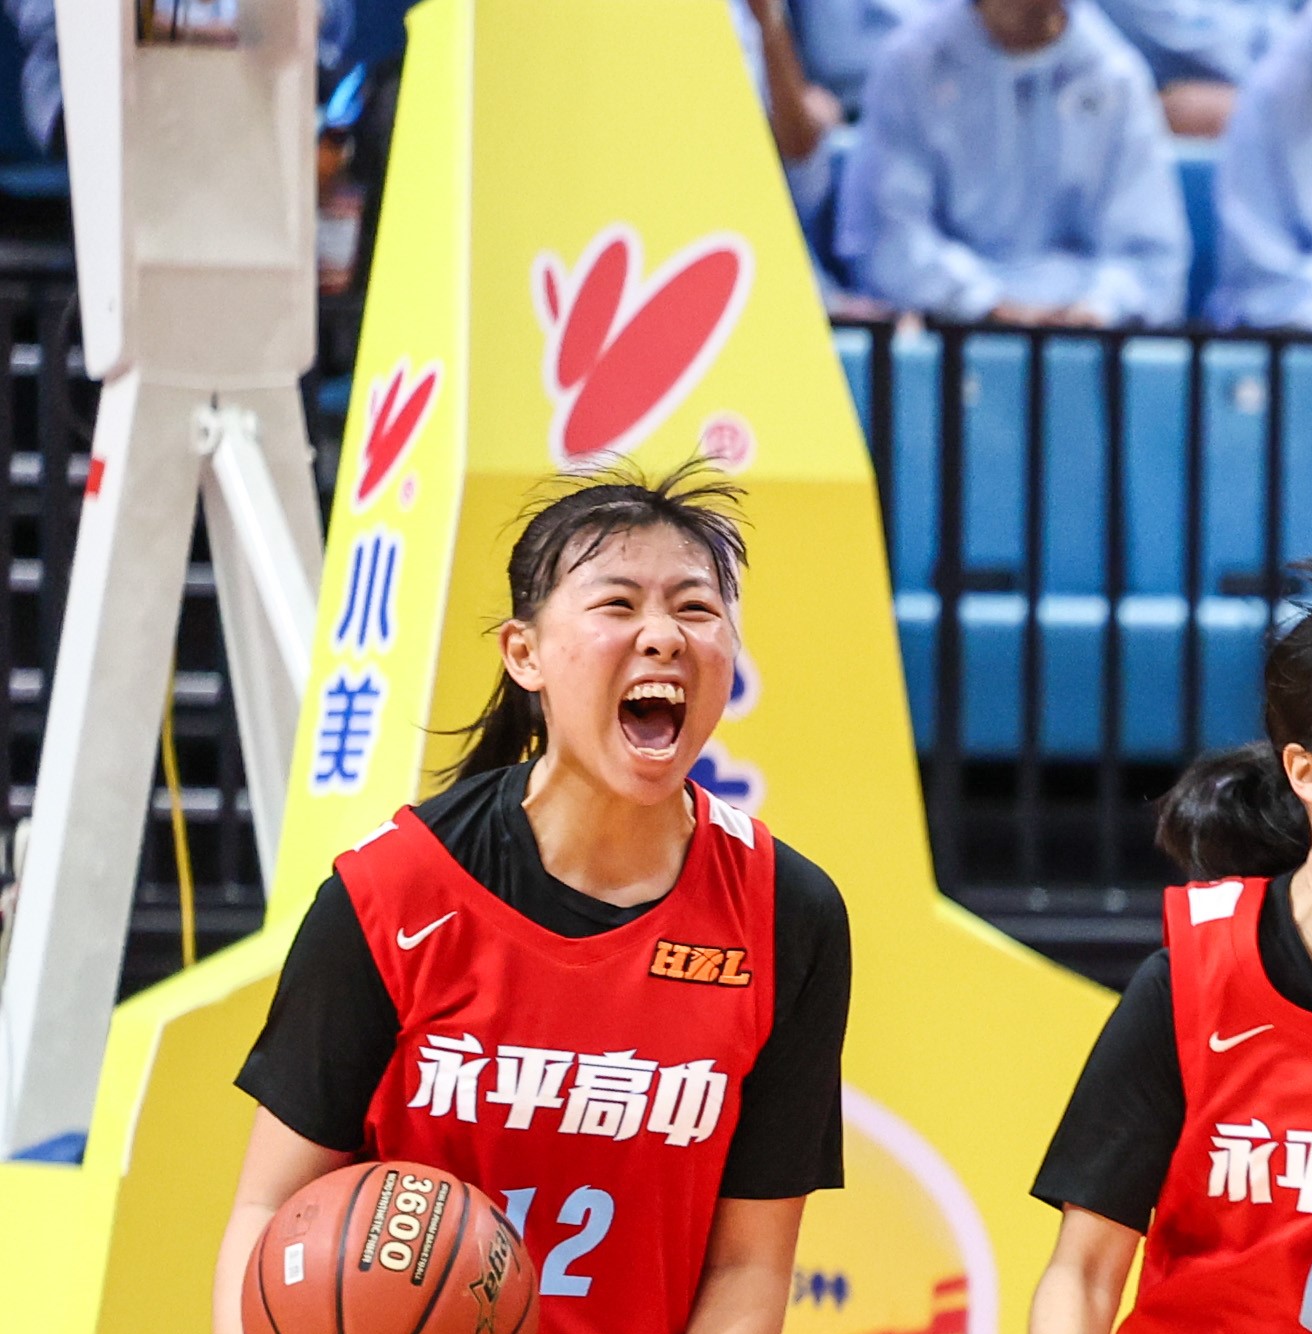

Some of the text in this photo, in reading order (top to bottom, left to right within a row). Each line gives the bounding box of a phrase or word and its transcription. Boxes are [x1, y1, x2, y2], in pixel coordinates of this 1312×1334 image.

[314, 536, 397, 784] 小美
[650, 941, 751, 986] HBL
[406, 1032, 728, 1147] 永平高中
[379, 1174, 433, 1271] 3600
